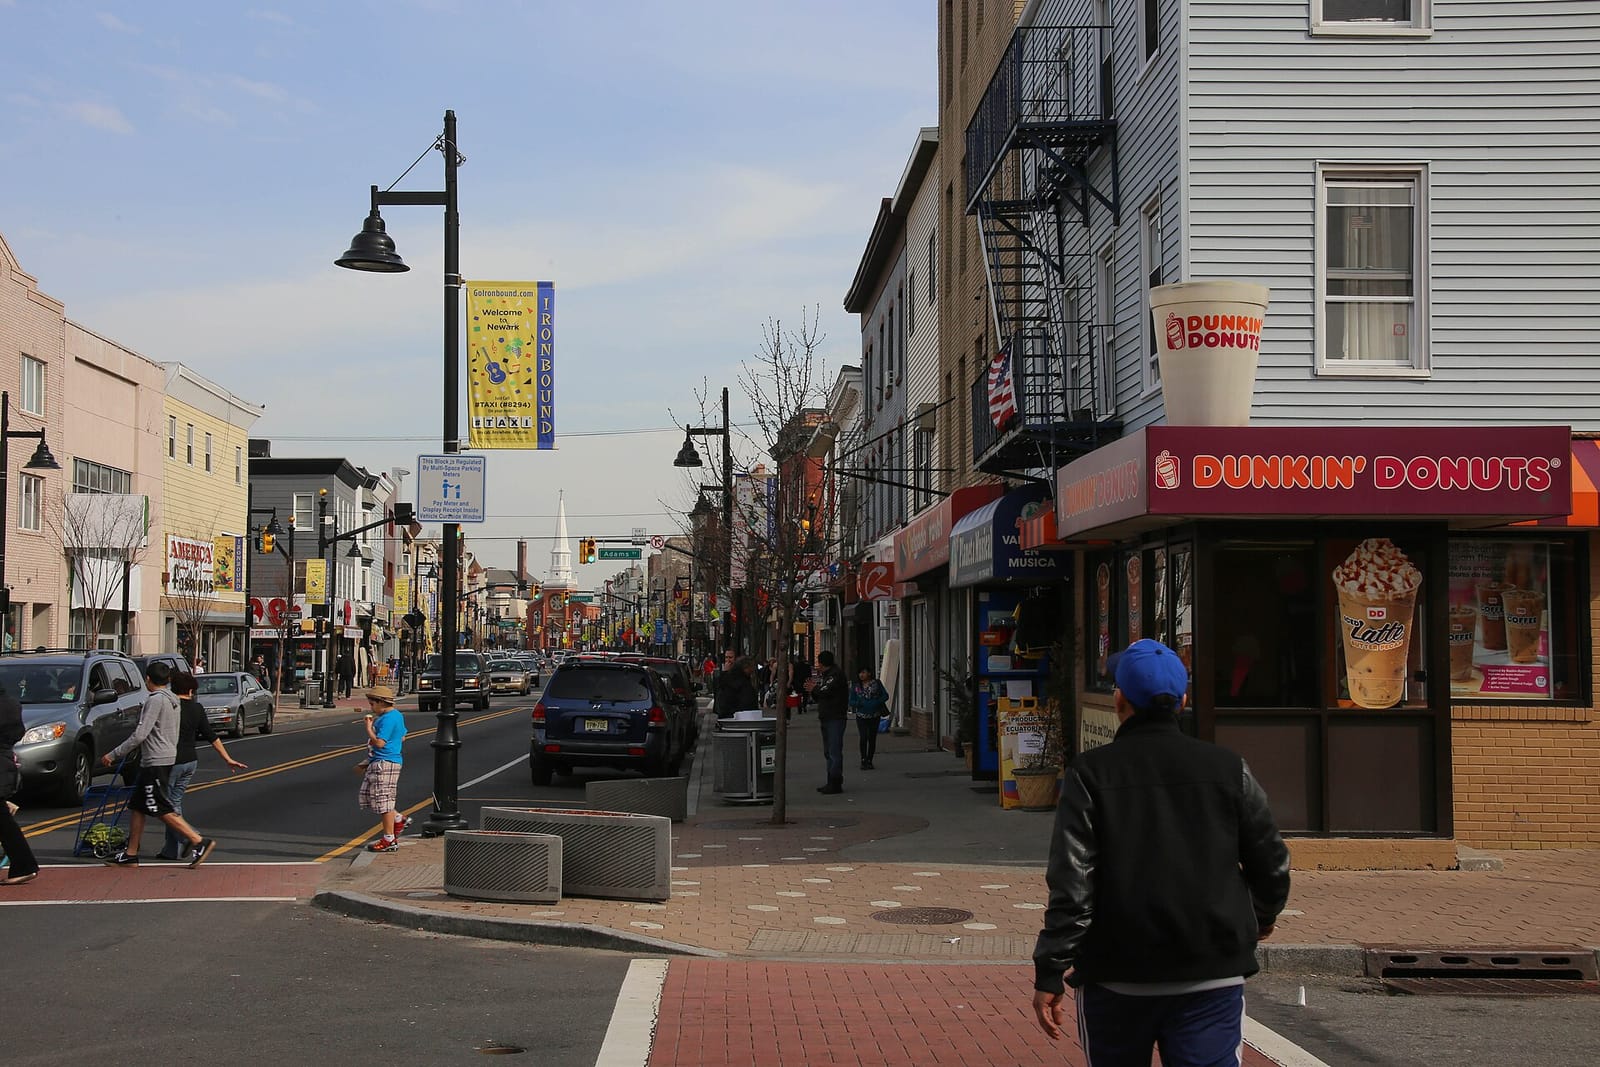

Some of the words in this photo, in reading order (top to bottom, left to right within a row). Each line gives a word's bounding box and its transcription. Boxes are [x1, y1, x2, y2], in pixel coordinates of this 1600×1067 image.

[473, 289, 534, 297] GoIronbound.com
[487, 323, 519, 331] Newark
[1187, 314, 1264, 334] DUNKIN'
[1188, 331, 1260, 352] DONUTS
[541, 297, 552, 434] IRONBOUND
[500, 401, 531, 409] (#8294)
[1193, 455, 1366, 490] DUNKIN'
[1097, 458, 1138, 508] DONUTS
[1008, 557, 1057, 568] MUSICA
[1507, 615, 1537, 624] COFFEE
[1350, 619, 1405, 644] Latte
